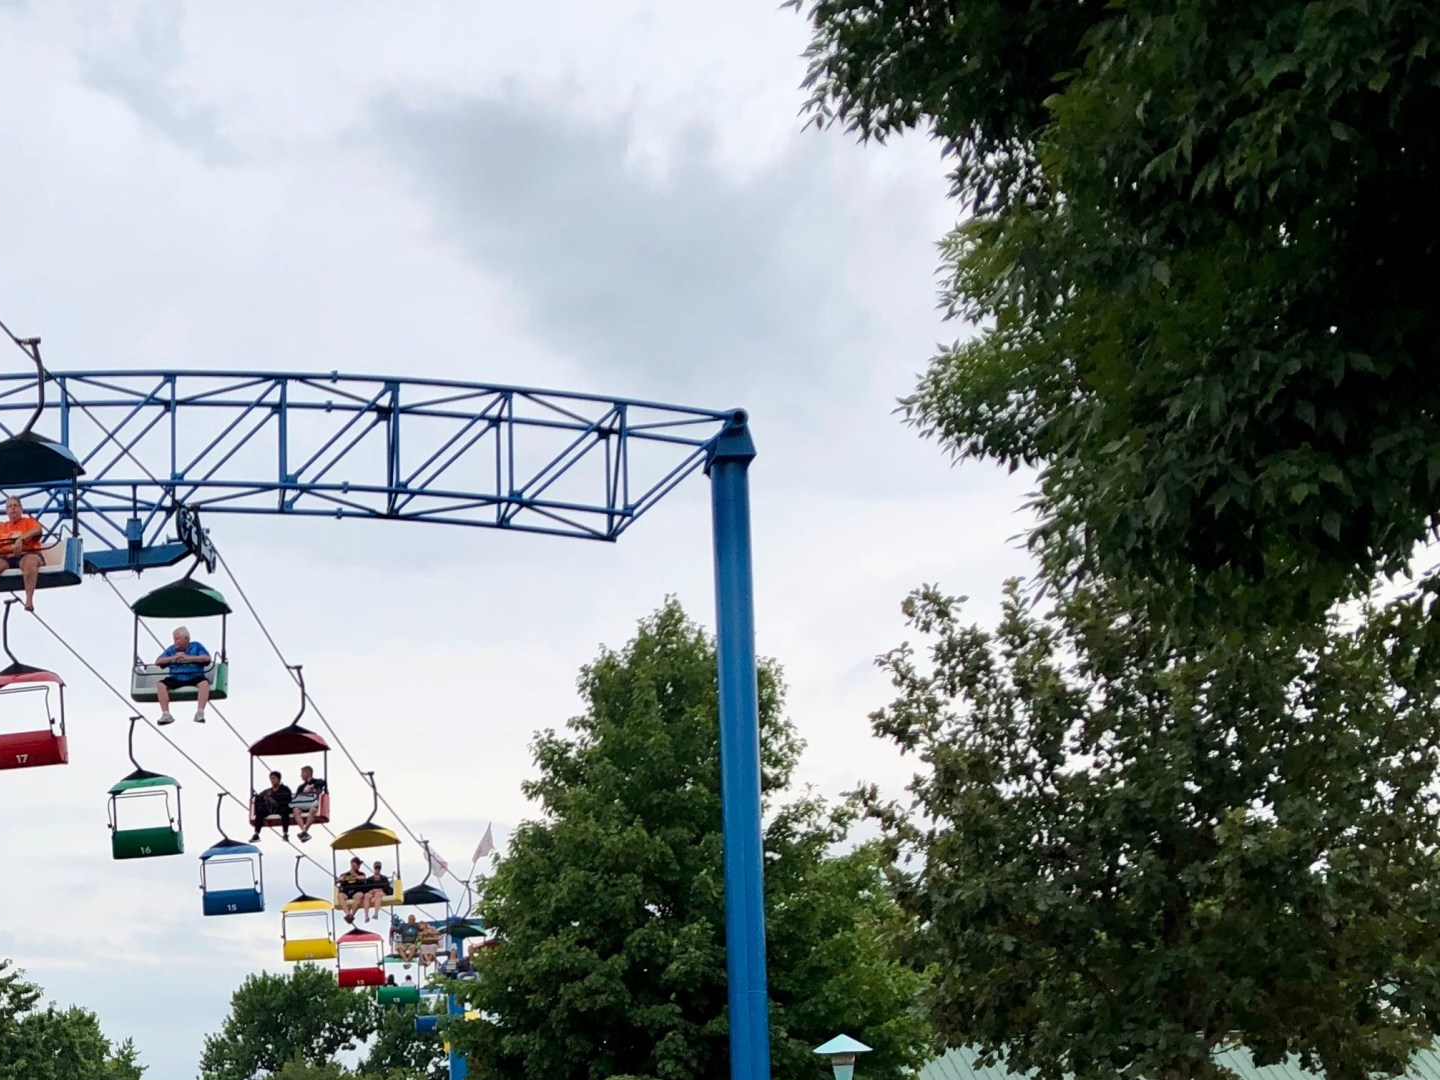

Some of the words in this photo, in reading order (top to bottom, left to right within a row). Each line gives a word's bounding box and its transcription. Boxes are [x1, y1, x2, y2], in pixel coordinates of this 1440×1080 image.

[15, 753, 29, 764] 17
[140, 846, 152, 855] 16
[226, 903, 237, 912] 15
